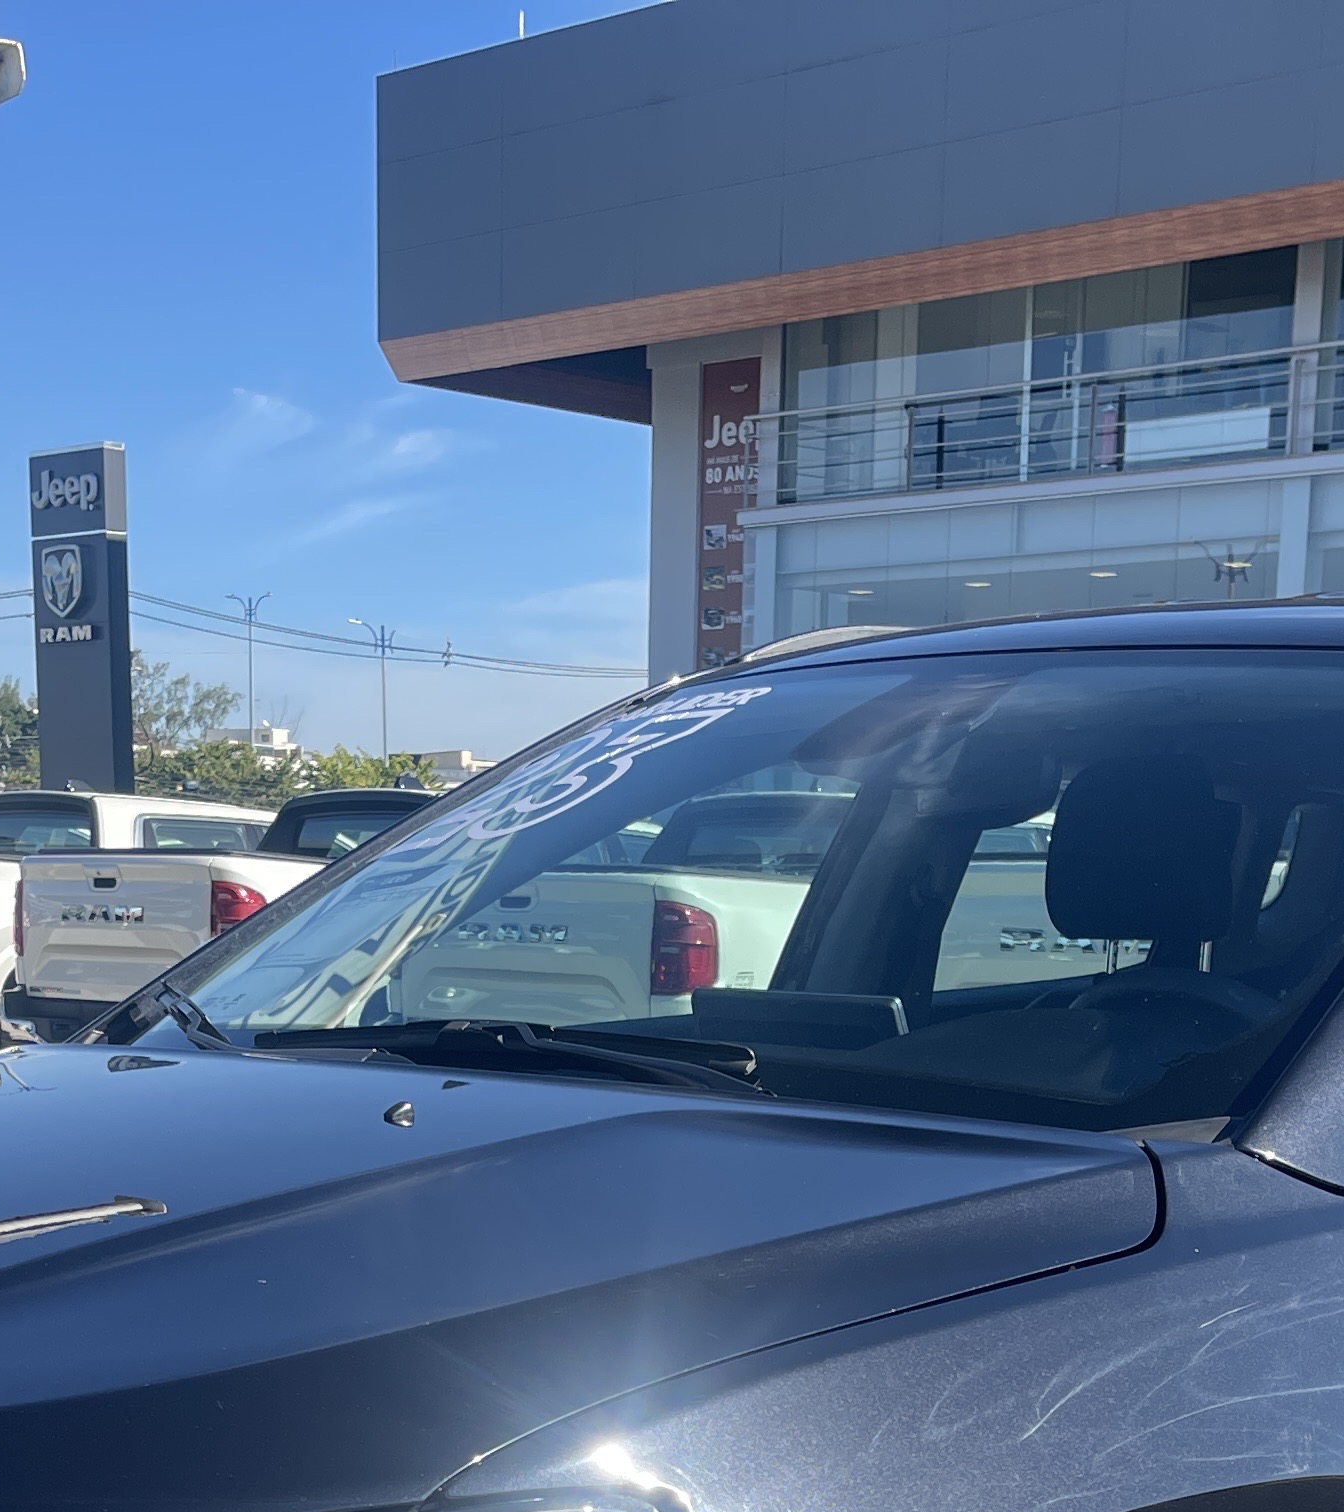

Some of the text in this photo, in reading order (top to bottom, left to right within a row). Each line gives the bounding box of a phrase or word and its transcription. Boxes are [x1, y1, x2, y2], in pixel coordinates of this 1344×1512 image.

[704, 415, 759, 451] Jee
[705, 467, 722, 484] 80
[32, 470, 98, 511] Jeep
[40, 624, 93, 643] RAM
[61, 904, 144, 923] RAM
[458, 922, 568, 943] RAM
